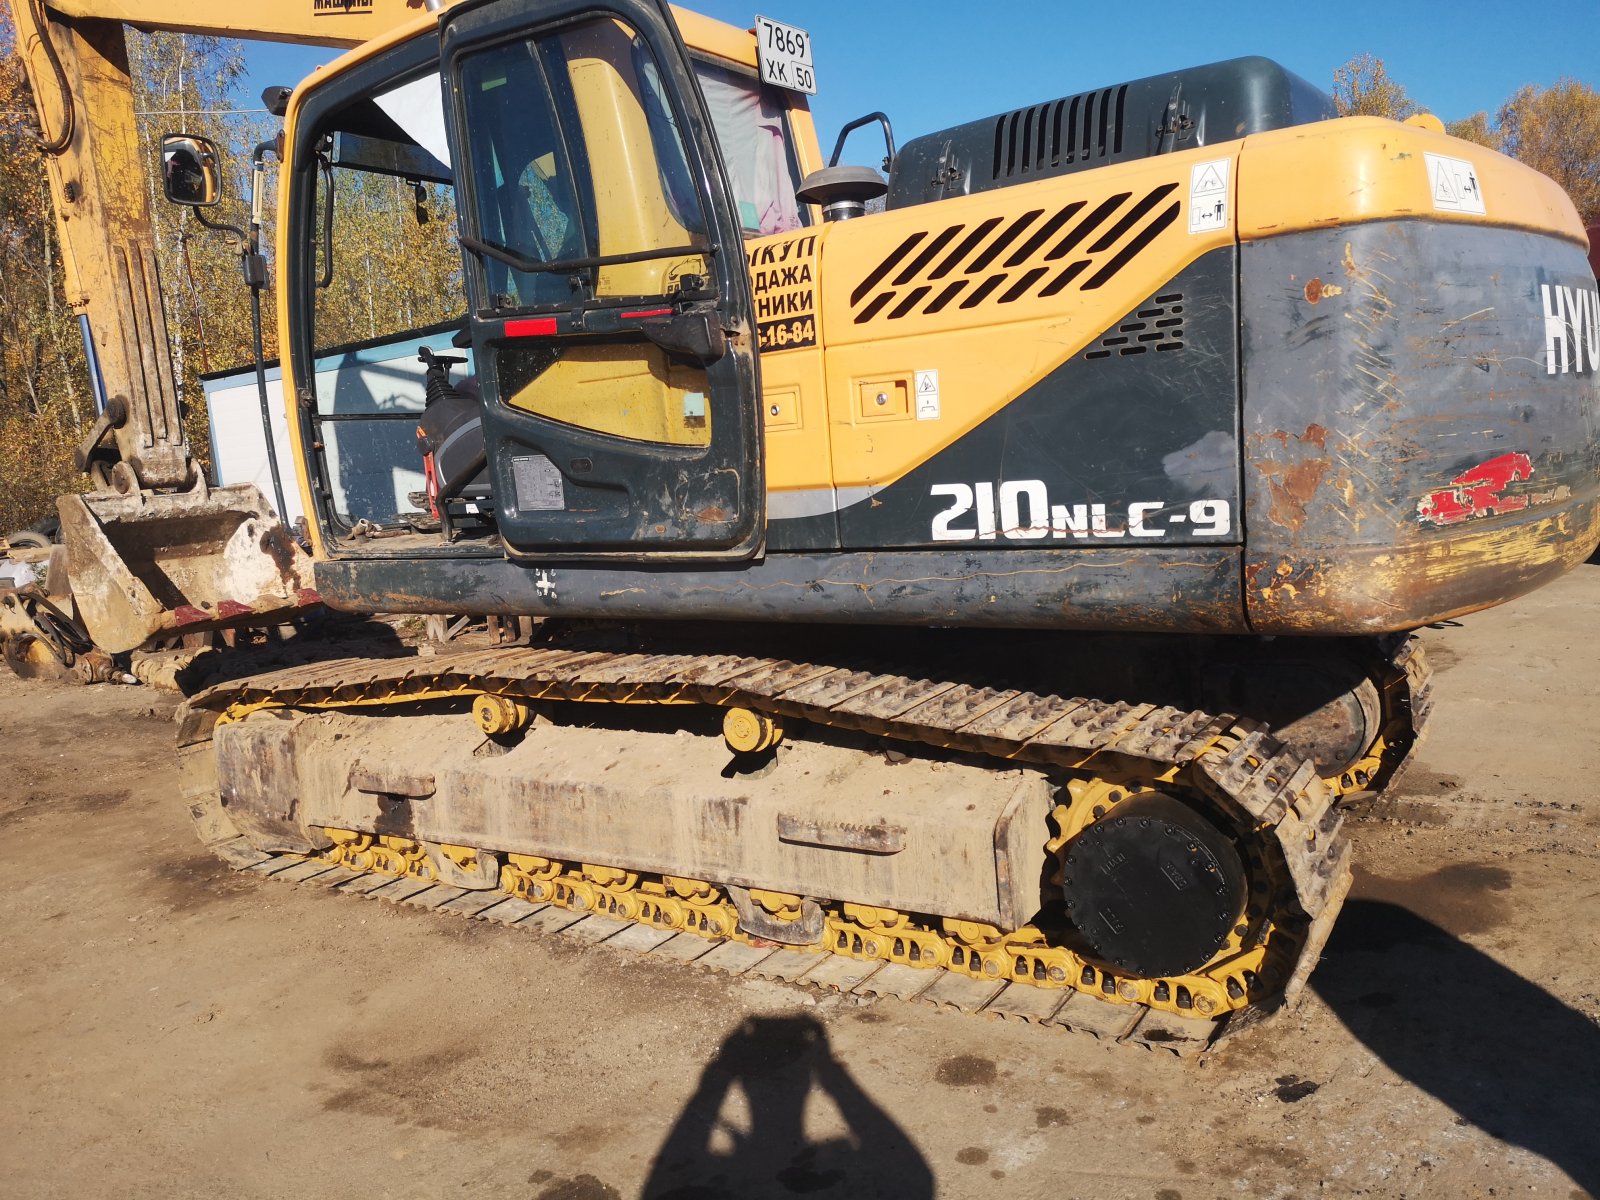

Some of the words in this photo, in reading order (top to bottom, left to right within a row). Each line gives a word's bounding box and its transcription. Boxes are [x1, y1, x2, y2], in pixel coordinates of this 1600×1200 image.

[763, 22, 805, 57] 7869
[766, 58, 788, 82] ХК
[796, 67, 812, 89] 50
[751, 264, 812, 295] ДАЖА
[754, 290, 813, 317] НИКИ
[1541, 284, 1600, 374] HYU
